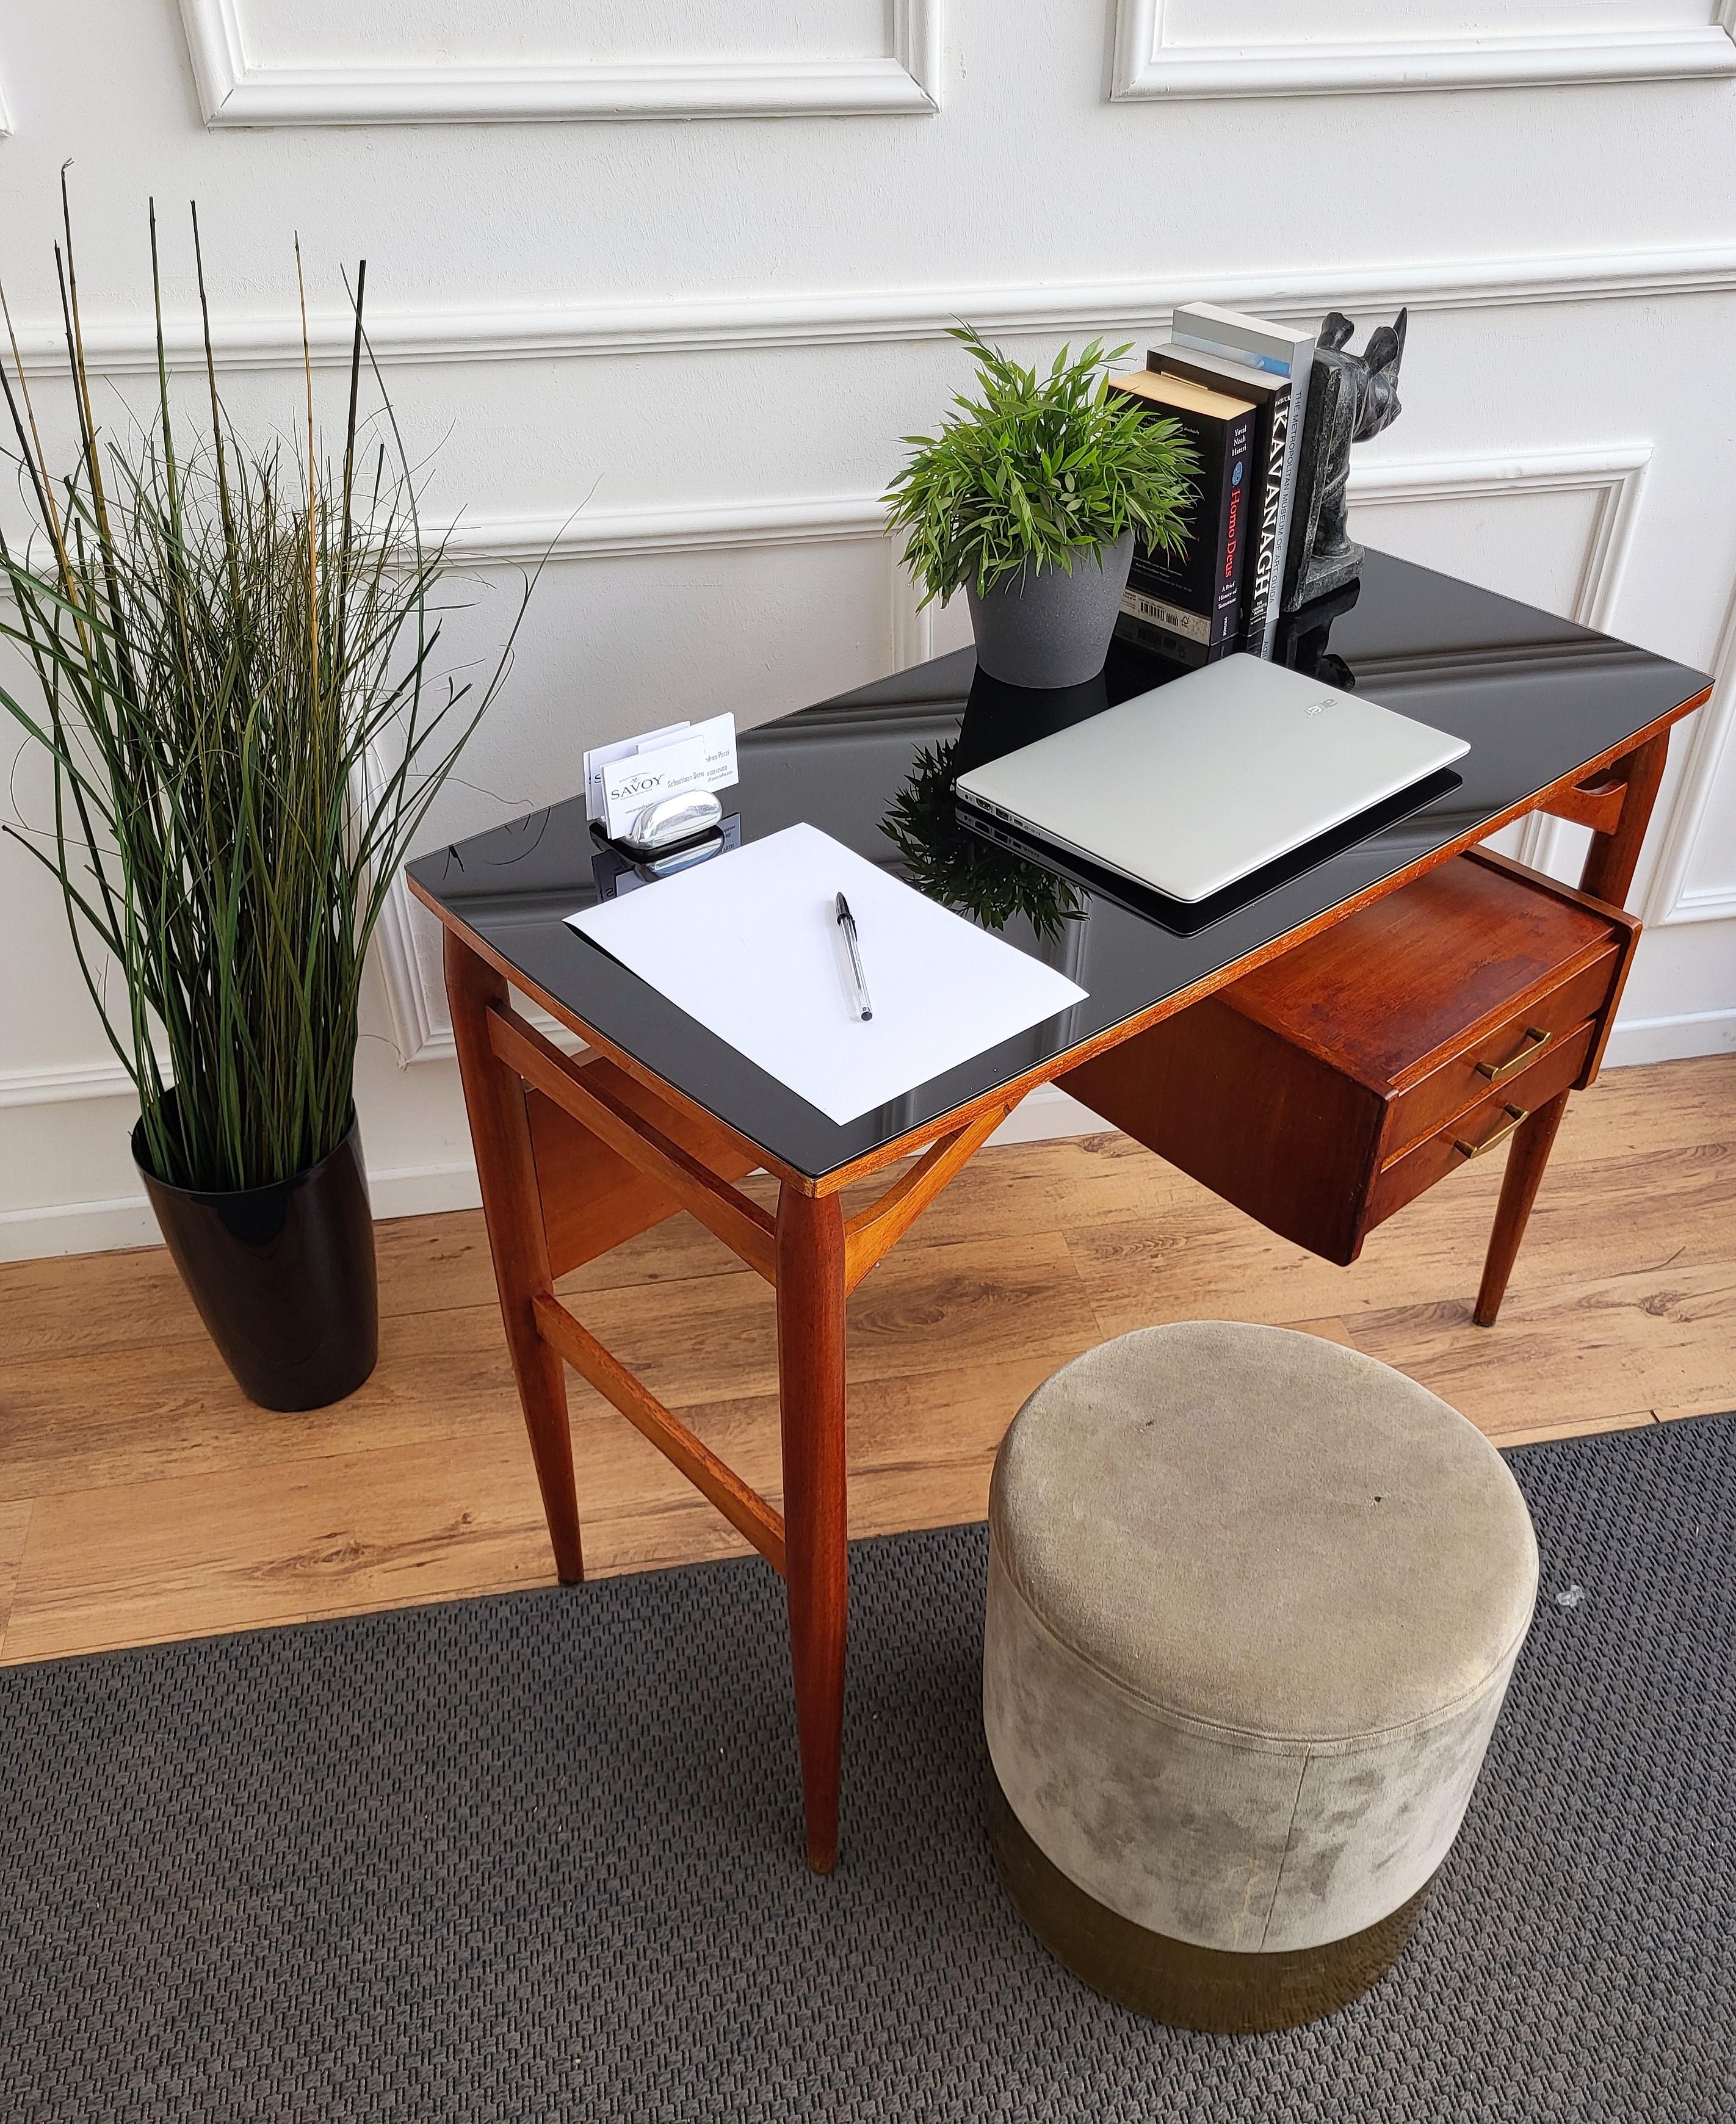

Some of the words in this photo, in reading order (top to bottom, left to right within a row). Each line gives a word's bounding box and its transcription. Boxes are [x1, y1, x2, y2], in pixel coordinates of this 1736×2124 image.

[1275, 395, 1291, 407] PATRICK
[1234, 424, 1246, 437] Yuval
[1234, 435, 1246, 447] Noah
[1232, 444, 1246, 457] Harari
[1284, 414, 1299, 490] METROPOLITAN
[1228, 489, 1240, 538] Homo
[1254, 406, 1288, 601] KAVANAGH
[1278, 493, 1289, 535] MUSEUM
[1276, 538, 1282, 551] OF
[1225, 540, 1236, 577] Deus
[1226, 580, 1236, 591] Brief
[1269, 575, 1278, 604] GUIDA
[611, 773, 665, 800] SAVOY
